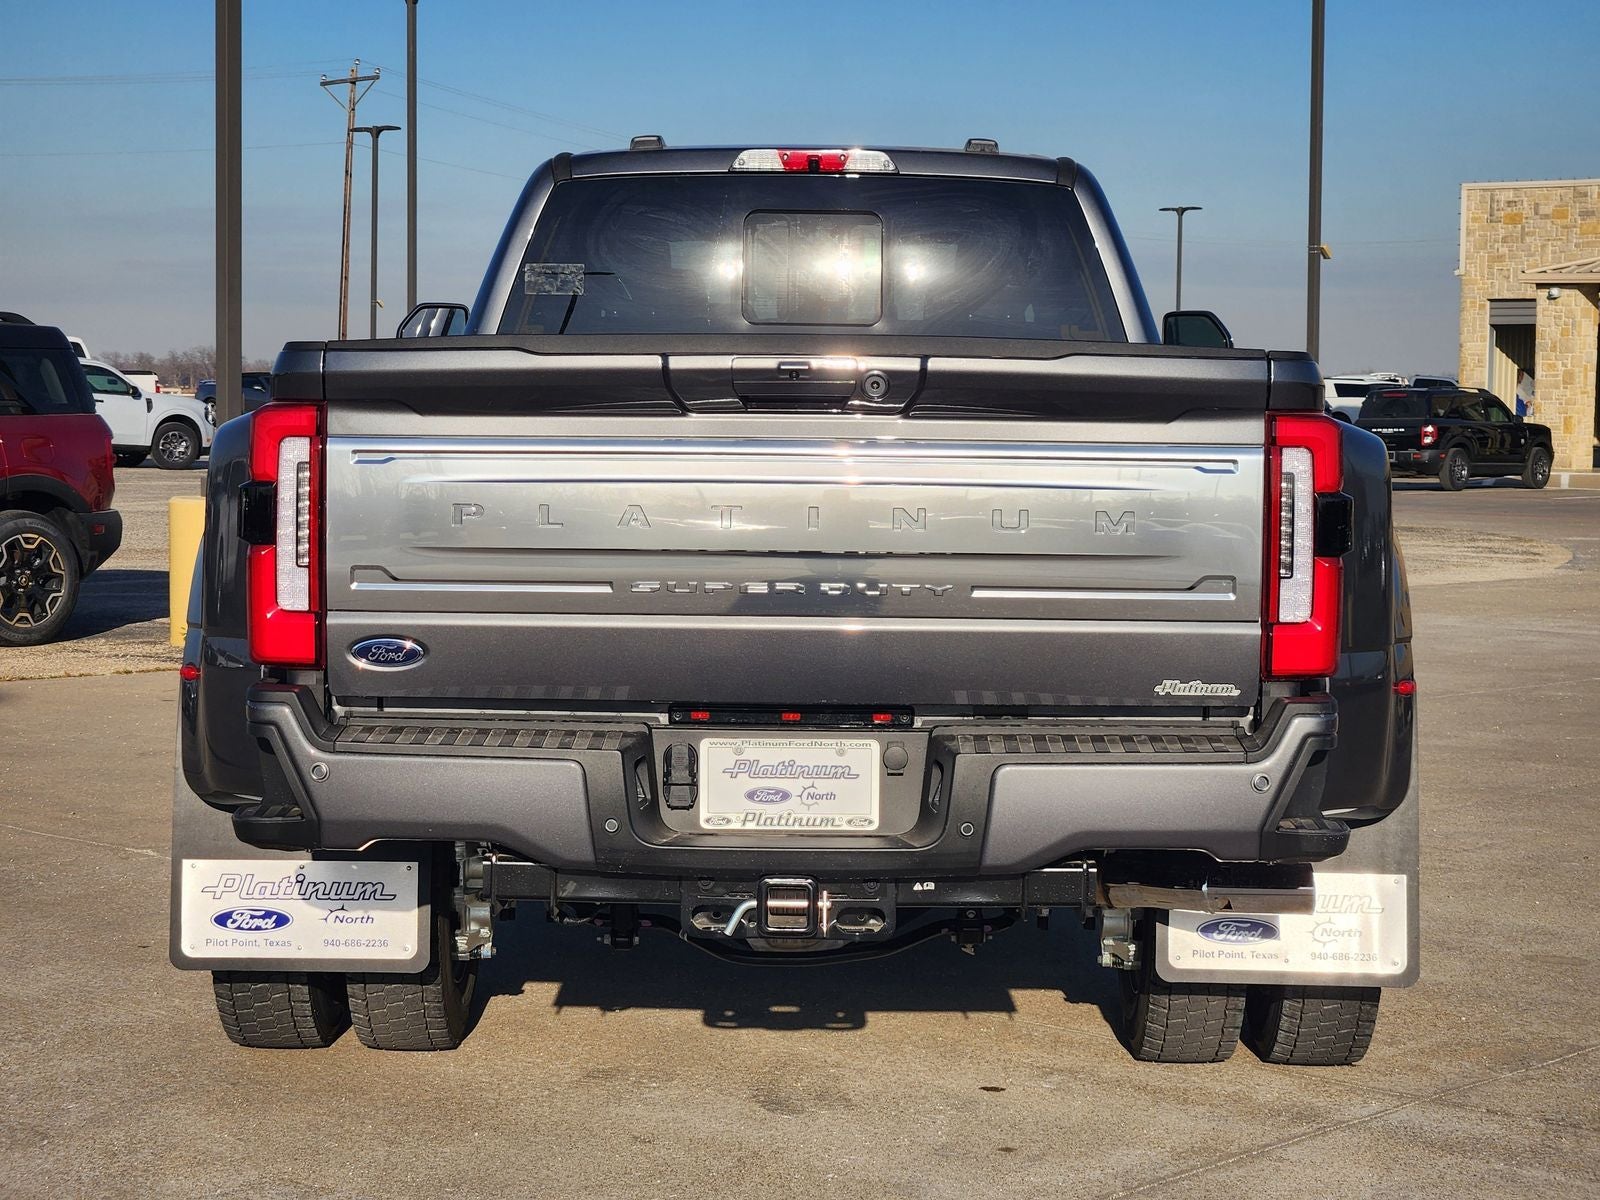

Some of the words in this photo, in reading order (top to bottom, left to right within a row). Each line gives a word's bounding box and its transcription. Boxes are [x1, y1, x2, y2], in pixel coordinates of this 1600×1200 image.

[451, 502, 1136, 535] PLATINUM
[630, 580, 805, 594] SUPER
[820, 582, 953, 597] DUTY
[1152, 679, 1241, 696] Platinum
[709, 740, 872, 749] www.PlatinumFordNorth.com
[722, 759, 860, 780] Platinum
[805, 791, 836, 801] North
[742, 812, 843, 828] Platinum
[201, 873, 397, 901] Platinum
[226, 910, 278, 930] Ford
[333, 913, 375, 925] North
[1212, 921, 1263, 941] Ford
[1321, 927, 1363, 938] North
[205, 938, 229, 948] Pilot
[231, 938, 261, 948] Point,
[263, 939, 292, 948] Texas
[323, 939, 389, 948] 940-686-2236
[1192, 950, 1216, 959] Pilot
[1251, 951, 1279, 960] Texas
[1310, 952, 1378, 962] 940-686-2236
